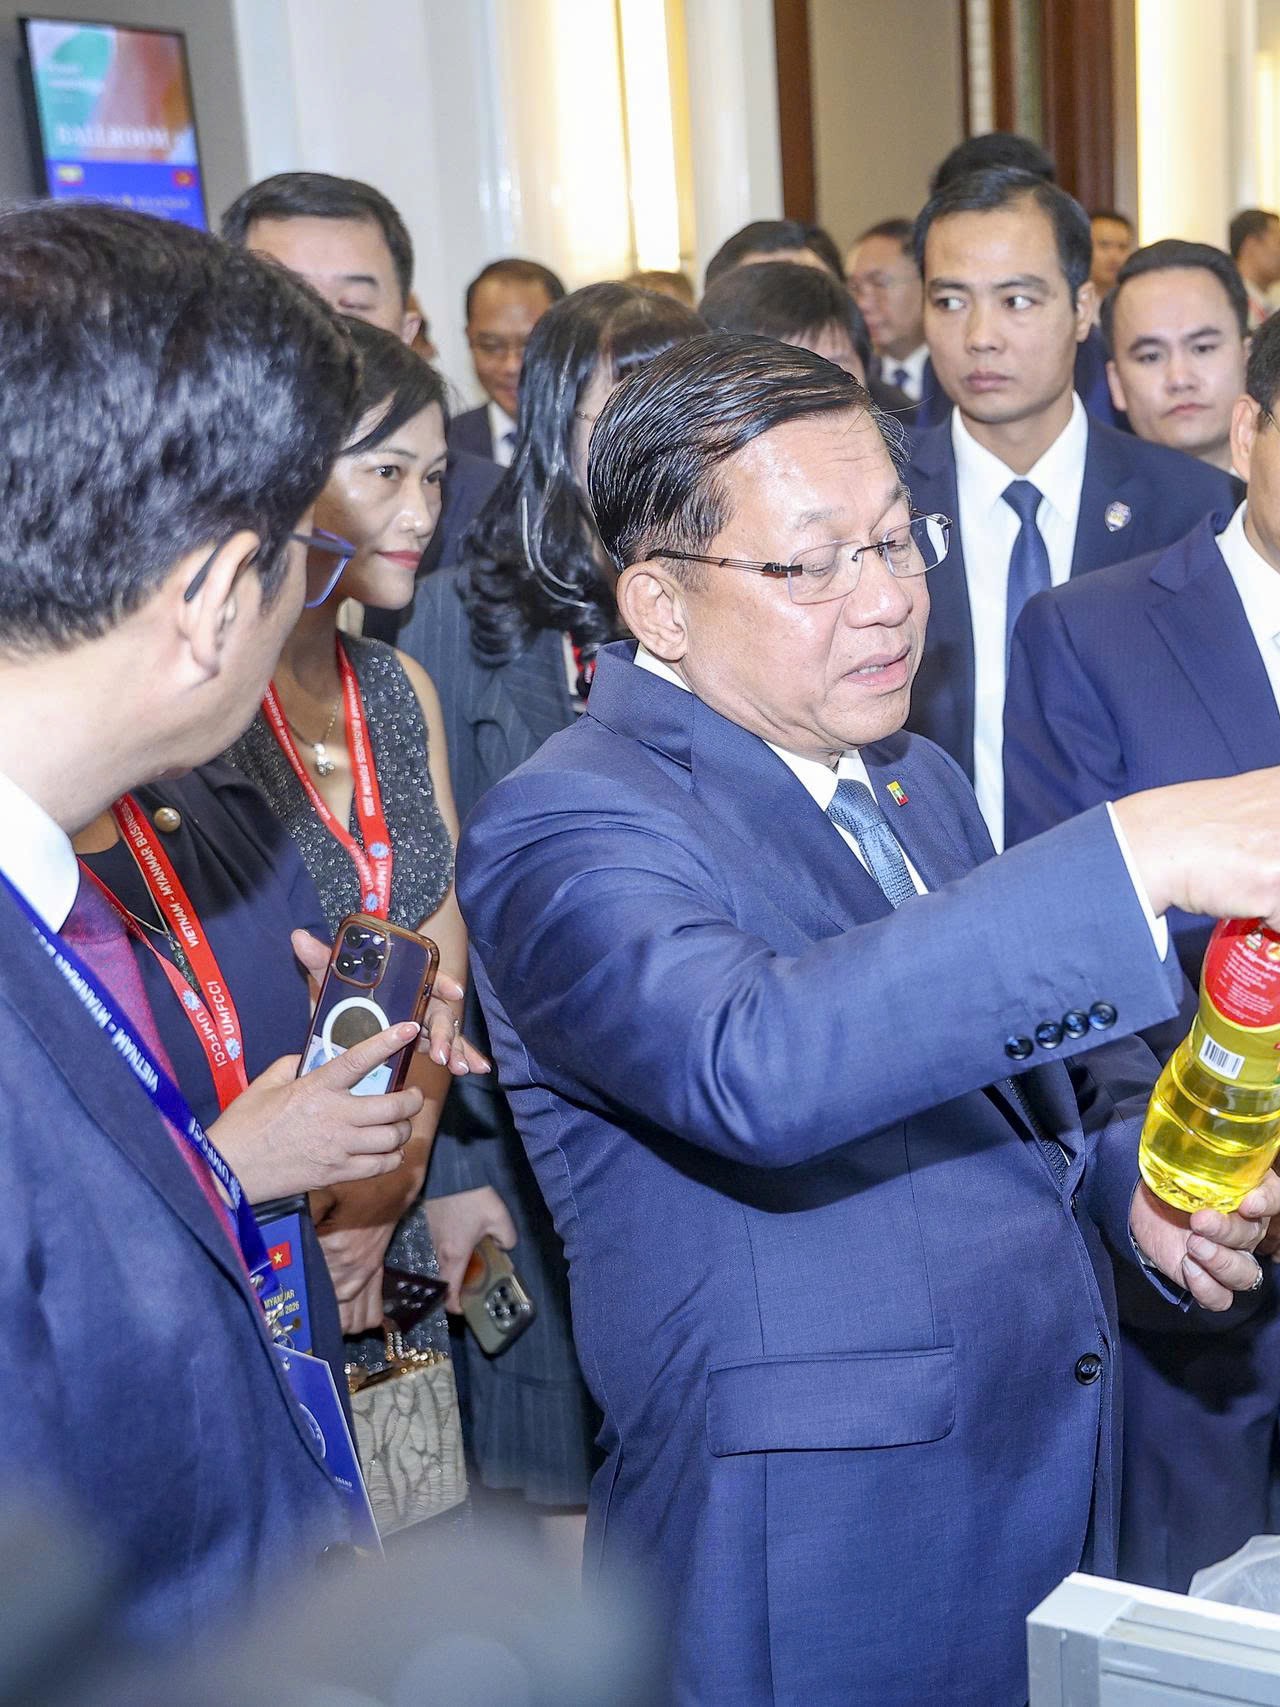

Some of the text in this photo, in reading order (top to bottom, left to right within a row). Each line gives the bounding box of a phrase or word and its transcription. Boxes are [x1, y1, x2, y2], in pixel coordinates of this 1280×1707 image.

[121, 802, 148, 848] BUSINESS
[140, 847, 174, 896] MYANMAR
[169, 902, 200, 948] VIETNAM
[206, 981, 235, 1035] UMFCCI
[112, 1027, 159, 1093] VIETNAM
[195, 1011, 228, 1067] UMFCCI
